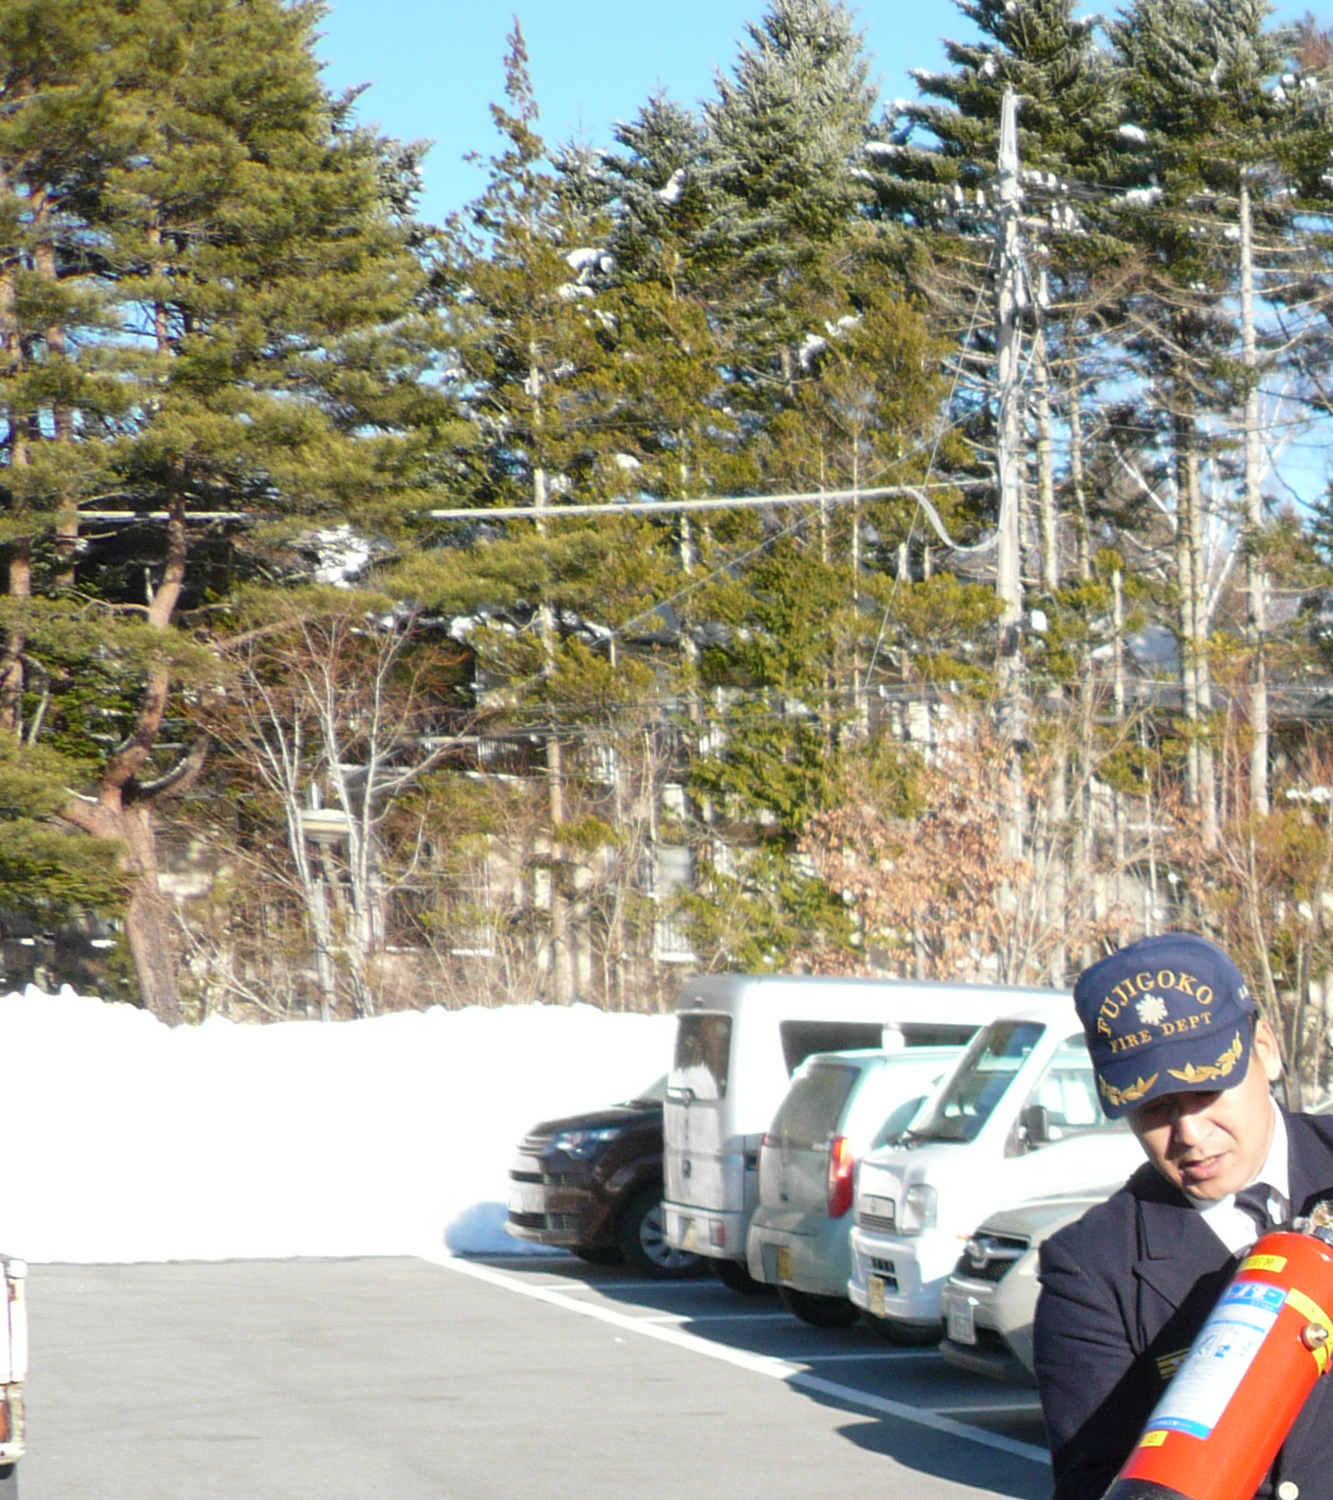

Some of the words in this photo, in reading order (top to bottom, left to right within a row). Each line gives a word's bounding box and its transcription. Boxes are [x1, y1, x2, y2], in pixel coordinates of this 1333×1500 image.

[1097, 970, 1213, 1037] FUJIGOKO
[1109, 1029, 1153, 1054] FIRE
[1160, 1011, 1213, 1036] DEPT
